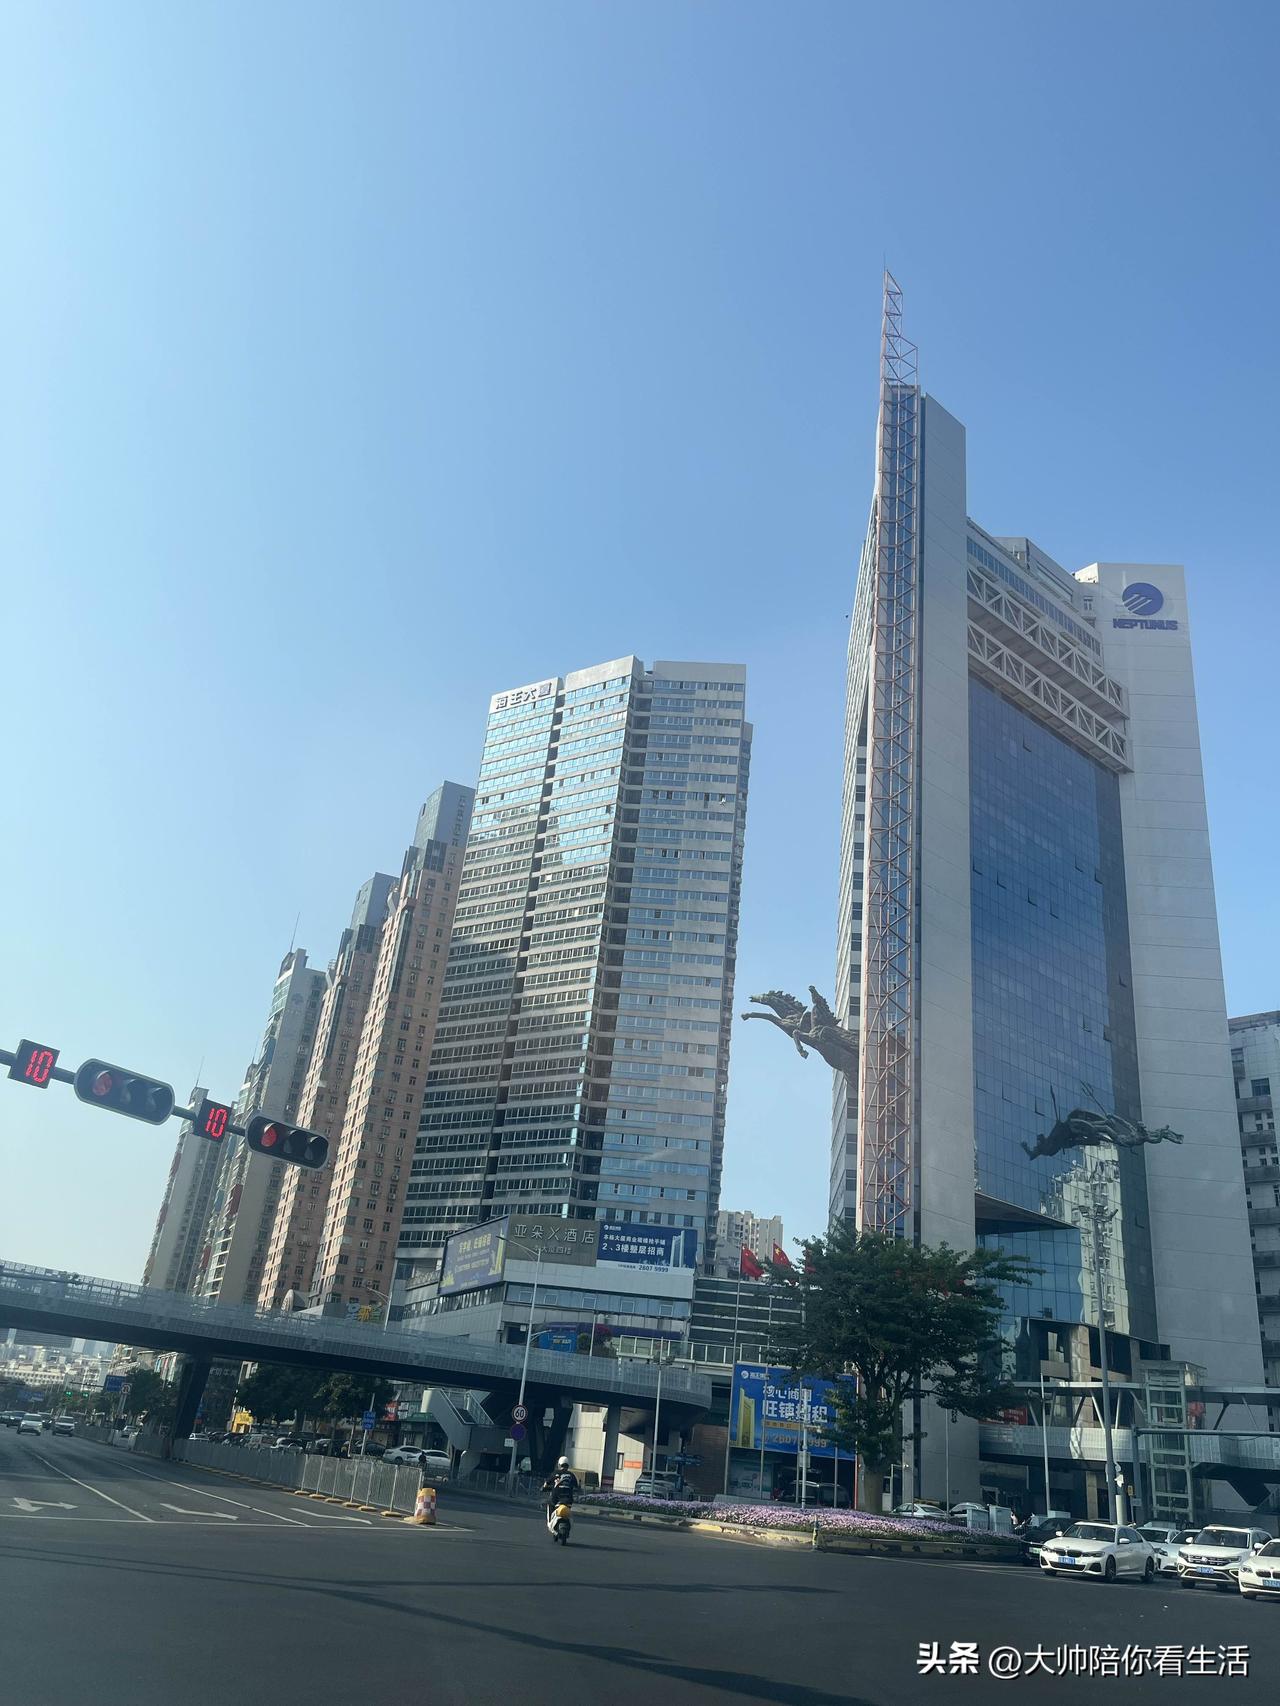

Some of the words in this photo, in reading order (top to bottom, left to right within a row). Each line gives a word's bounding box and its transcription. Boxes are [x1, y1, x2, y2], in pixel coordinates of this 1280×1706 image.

[1112, 618, 1178, 631] NEPTUNUS
[25, 1048, 54, 1083] 10
[205, 1107, 228, 1138] 10
[515, 1408, 525, 1418] 60
